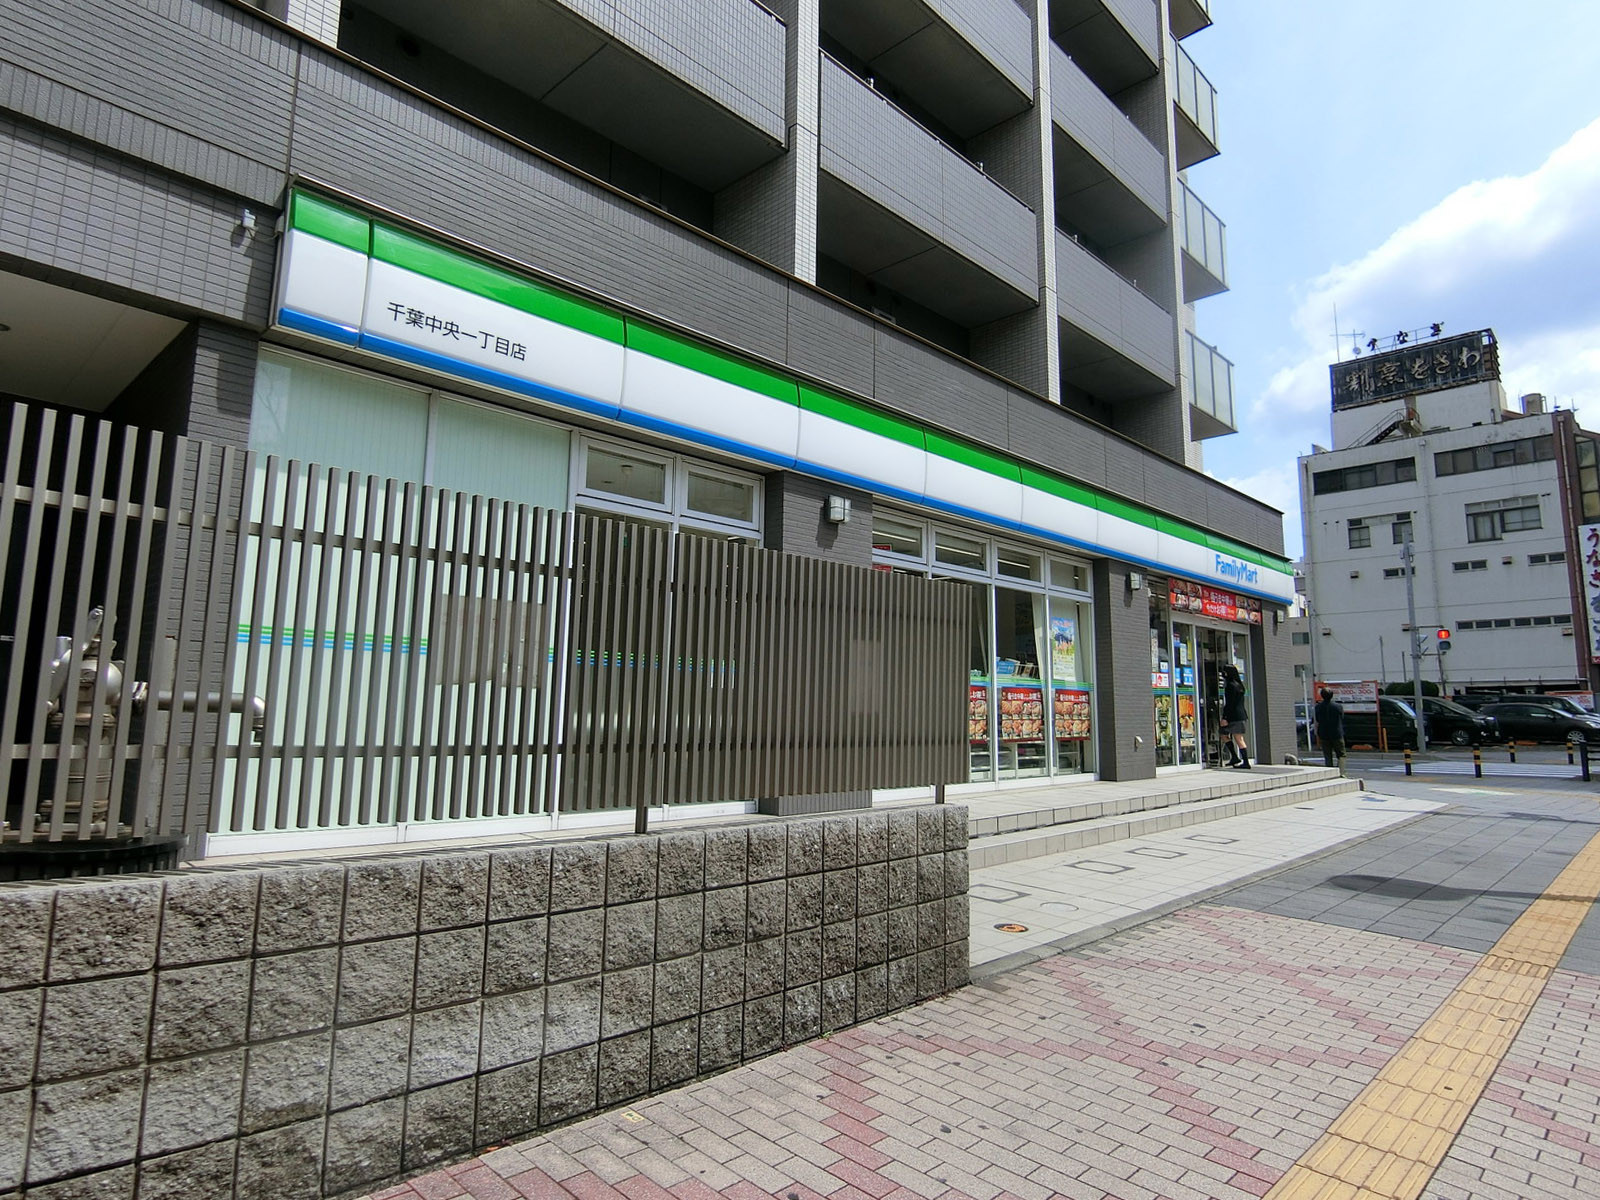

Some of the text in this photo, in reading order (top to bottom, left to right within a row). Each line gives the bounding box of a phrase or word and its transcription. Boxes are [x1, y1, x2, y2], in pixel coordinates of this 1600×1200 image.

[387, 301, 527, 362] 千葉中央一丁目店
[1215, 553, 1258, 584] FamilyMart
